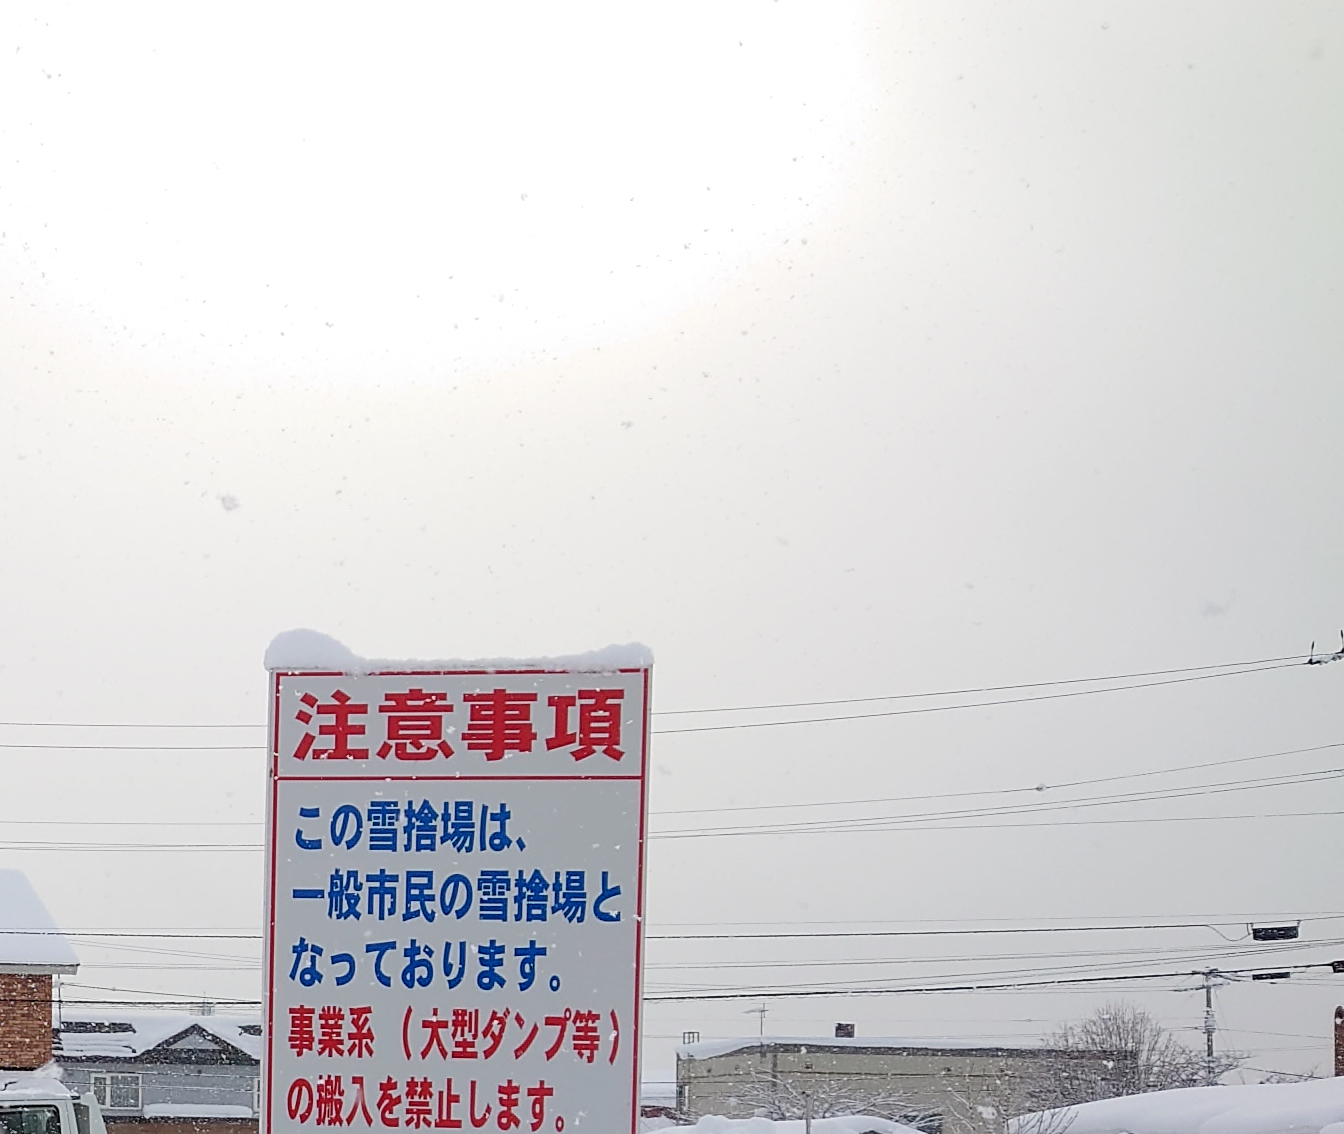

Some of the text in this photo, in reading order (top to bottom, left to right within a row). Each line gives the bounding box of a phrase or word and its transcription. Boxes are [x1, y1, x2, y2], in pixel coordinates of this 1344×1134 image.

[292, 689, 626, 762] 注意事項
[294, 800, 527, 854] この雪捨場は、
[291, 868, 623, 924] 一般市民の雪捨場と
[288, 936, 562, 993] なっております。
[286, 1074, 566, 1133] の搬入を禁止します。
